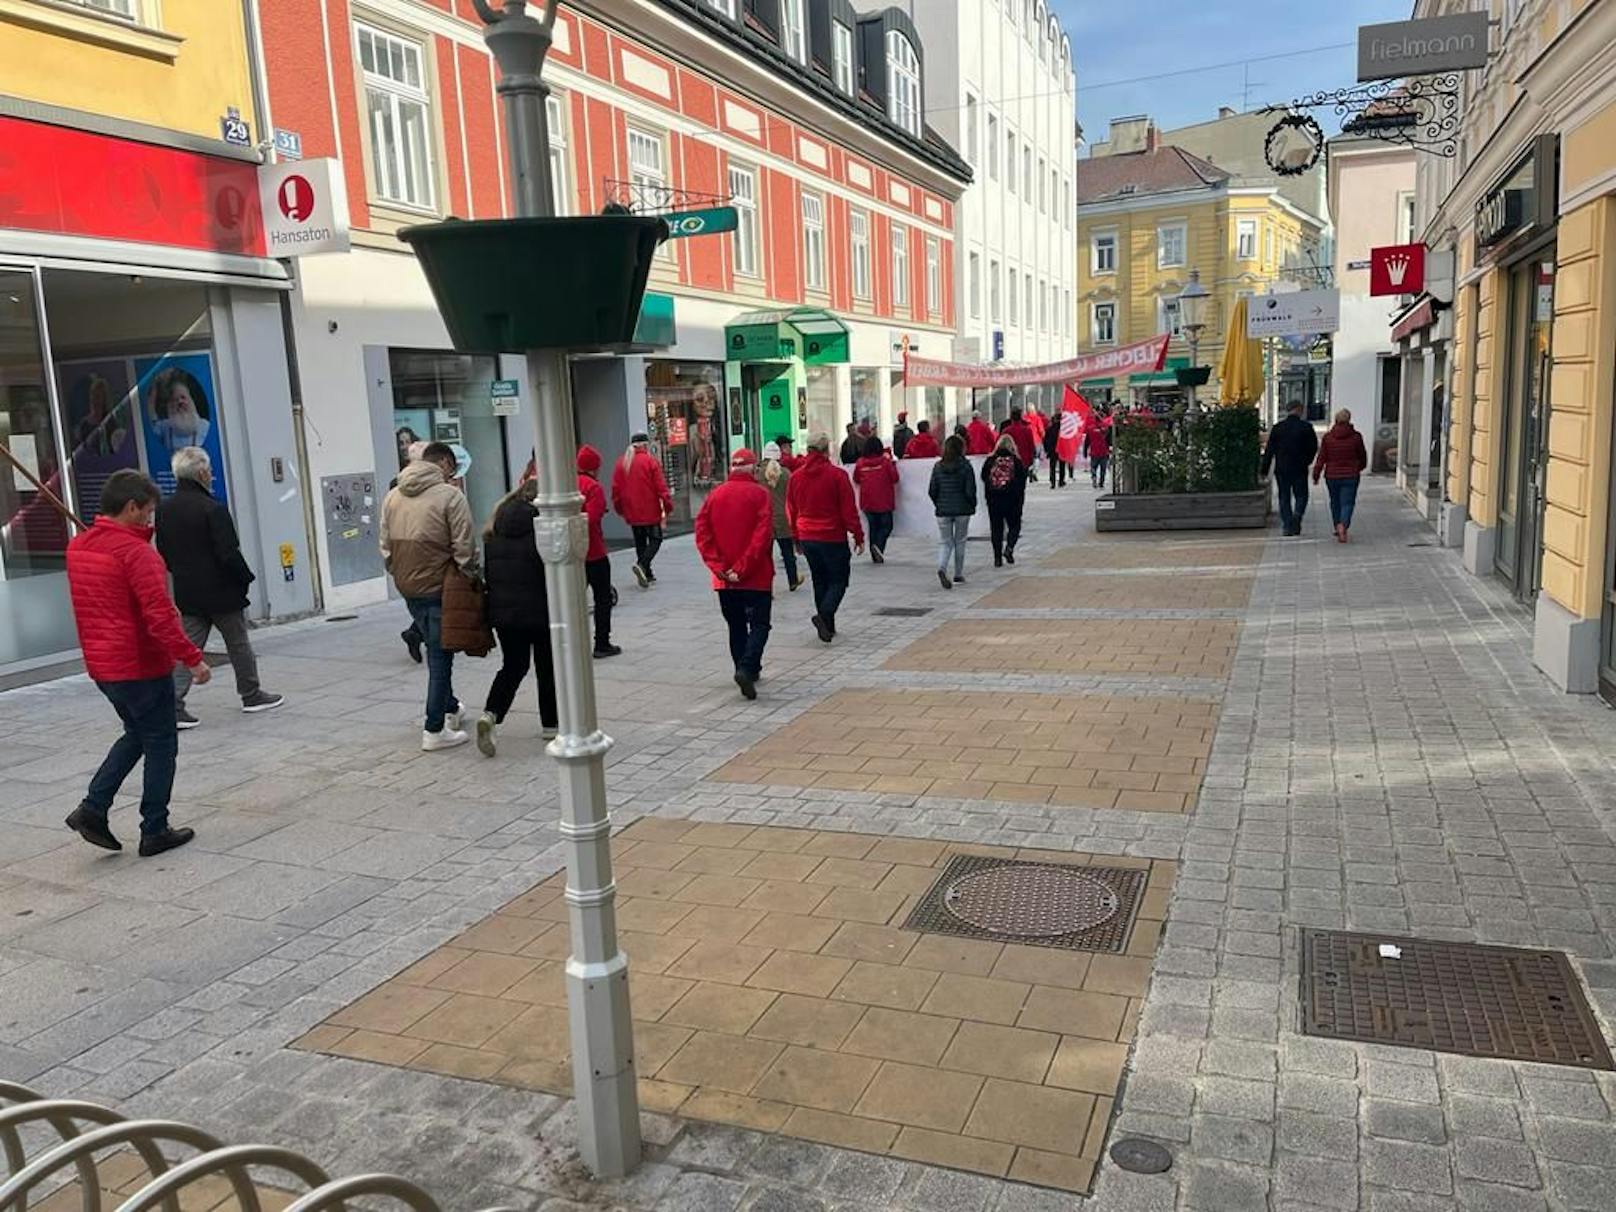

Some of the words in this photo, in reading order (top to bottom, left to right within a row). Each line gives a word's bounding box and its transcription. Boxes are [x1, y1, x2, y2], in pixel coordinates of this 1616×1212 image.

[1371, 34, 1476, 60] fielmann
[226, 121, 247, 138] 29
[281, 133, 297, 150] 31
[271, 227, 330, 245] Hansaton
